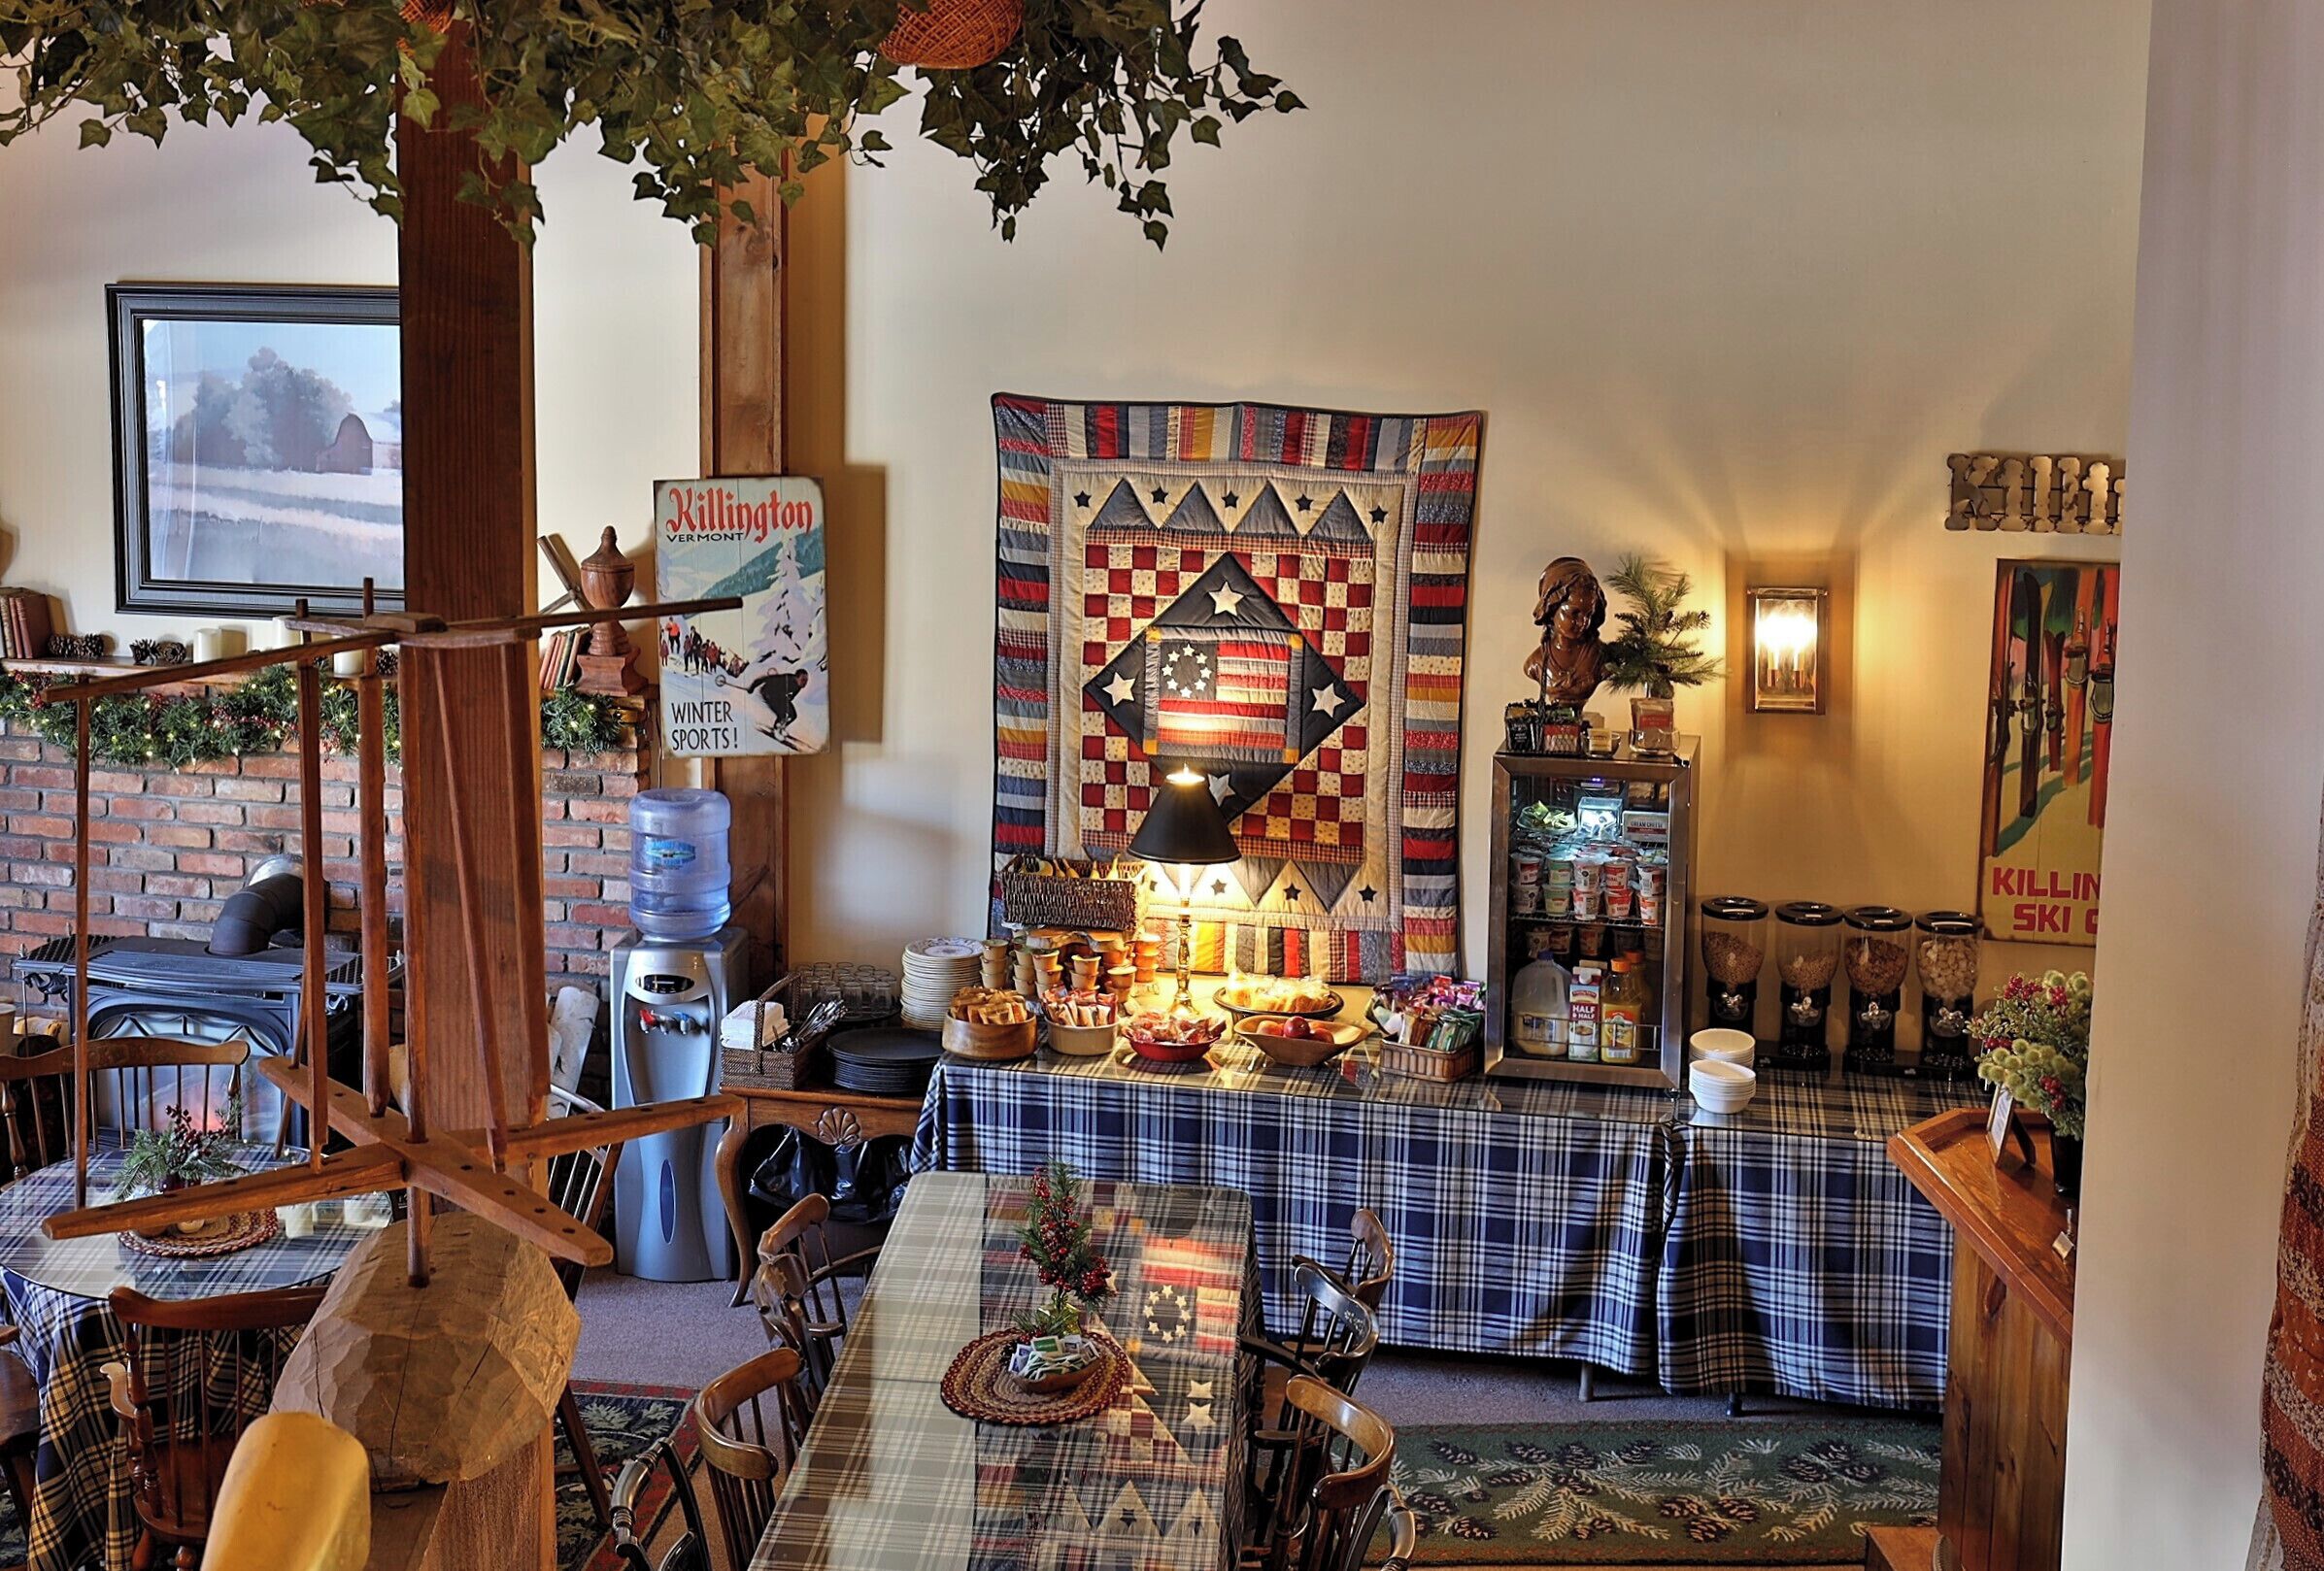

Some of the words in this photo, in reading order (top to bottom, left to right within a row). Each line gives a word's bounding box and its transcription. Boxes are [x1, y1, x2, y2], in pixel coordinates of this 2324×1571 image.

[665, 486, 813, 544] Killington
[666, 532, 744, 543] VERMONT
[671, 701, 733, 723] WINTER
[671, 727, 738, 751] SPORTS!
[2013, 903, 2071, 933] SKI
[1572, 1005, 1596, 1014] HALF
